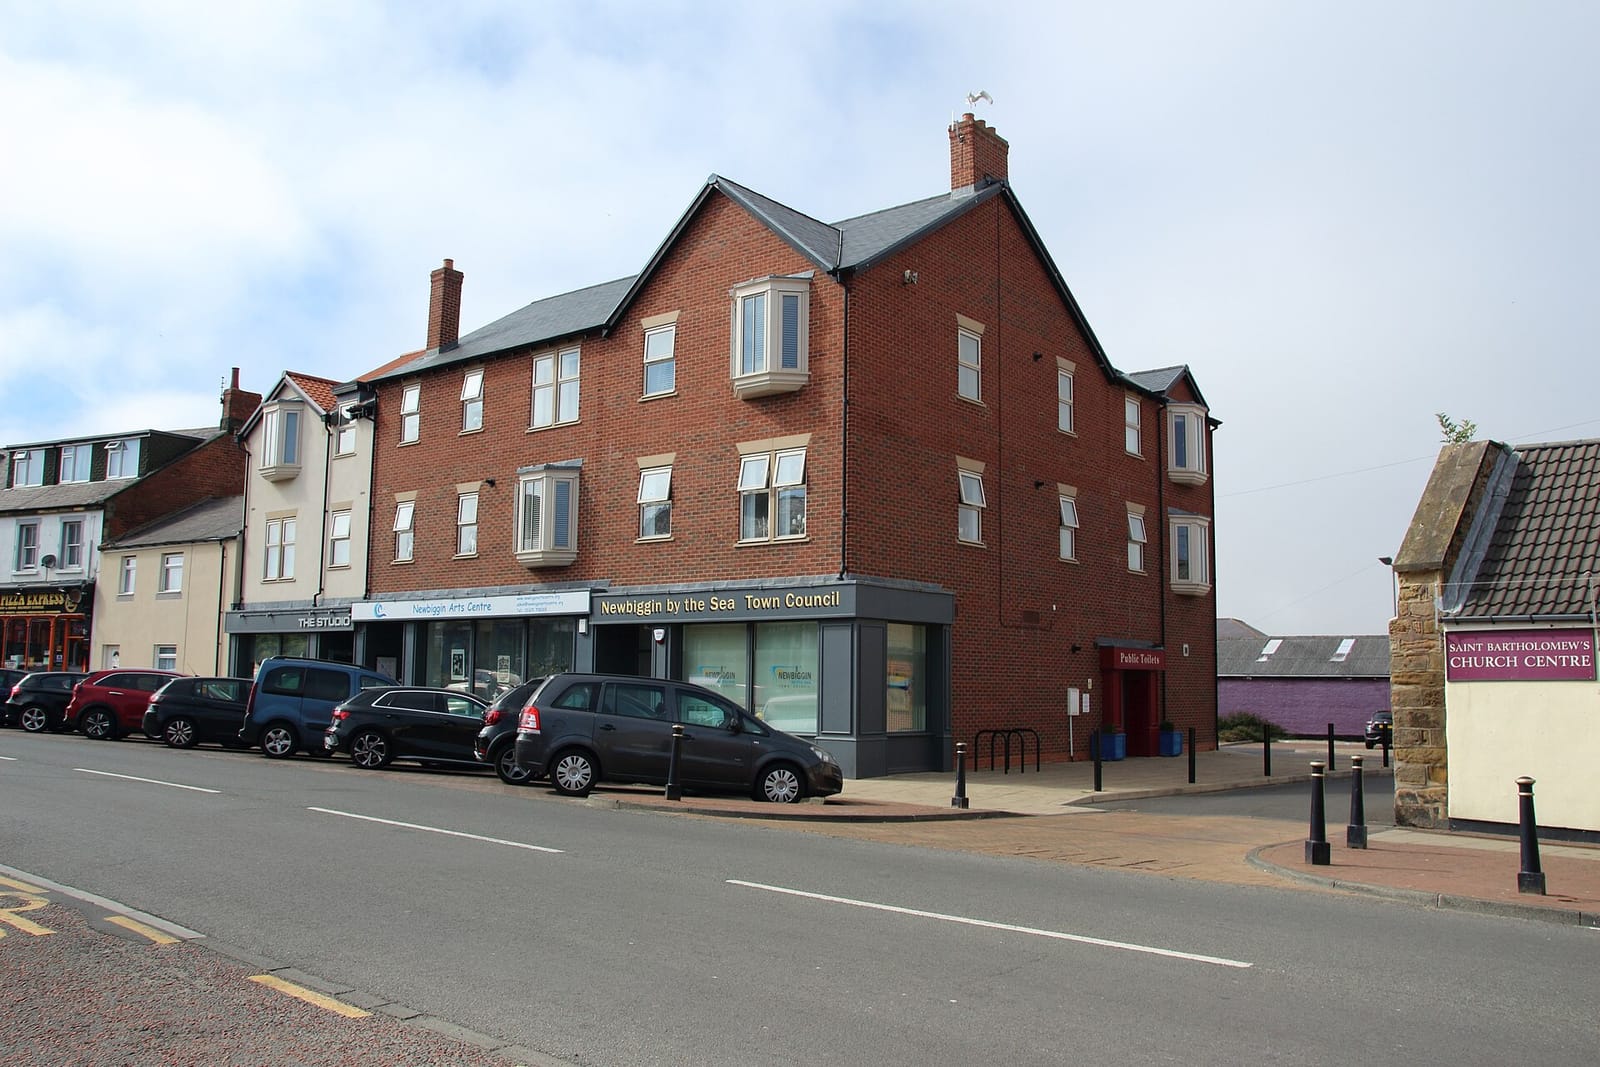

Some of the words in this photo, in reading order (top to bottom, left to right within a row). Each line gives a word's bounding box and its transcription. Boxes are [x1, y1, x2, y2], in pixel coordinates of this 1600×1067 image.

[1, 594, 25, 606] PIZZA
[26, 593, 65, 606] EXPRESS
[601, 599, 662, 617] Newbiggin
[666, 598, 680, 615] by
[684, 597, 705, 612] the
[710, 596, 735, 611] Sea
[745, 594, 780, 610] Town
[785, 591, 840, 607] Council
[412, 604, 447, 616] Newbiggin
[449, 602, 465, 613] Arts
[467, 601, 492, 612] Centre
[298, 618, 315, 628] THE
[317, 616, 351, 628] STUDIO
[1449, 643, 1484, 653] SAINT
[1487, 641, 1591, 652] BARTHOLOMEW'S
[1120, 652, 1139, 664] Public
[1140, 653, 1160, 665] Toilets
[1450, 656, 1518, 668] CHURCH
[1524, 655, 1591, 667] CENTRE
[778, 671, 812, 681] NEWBIGGIN
